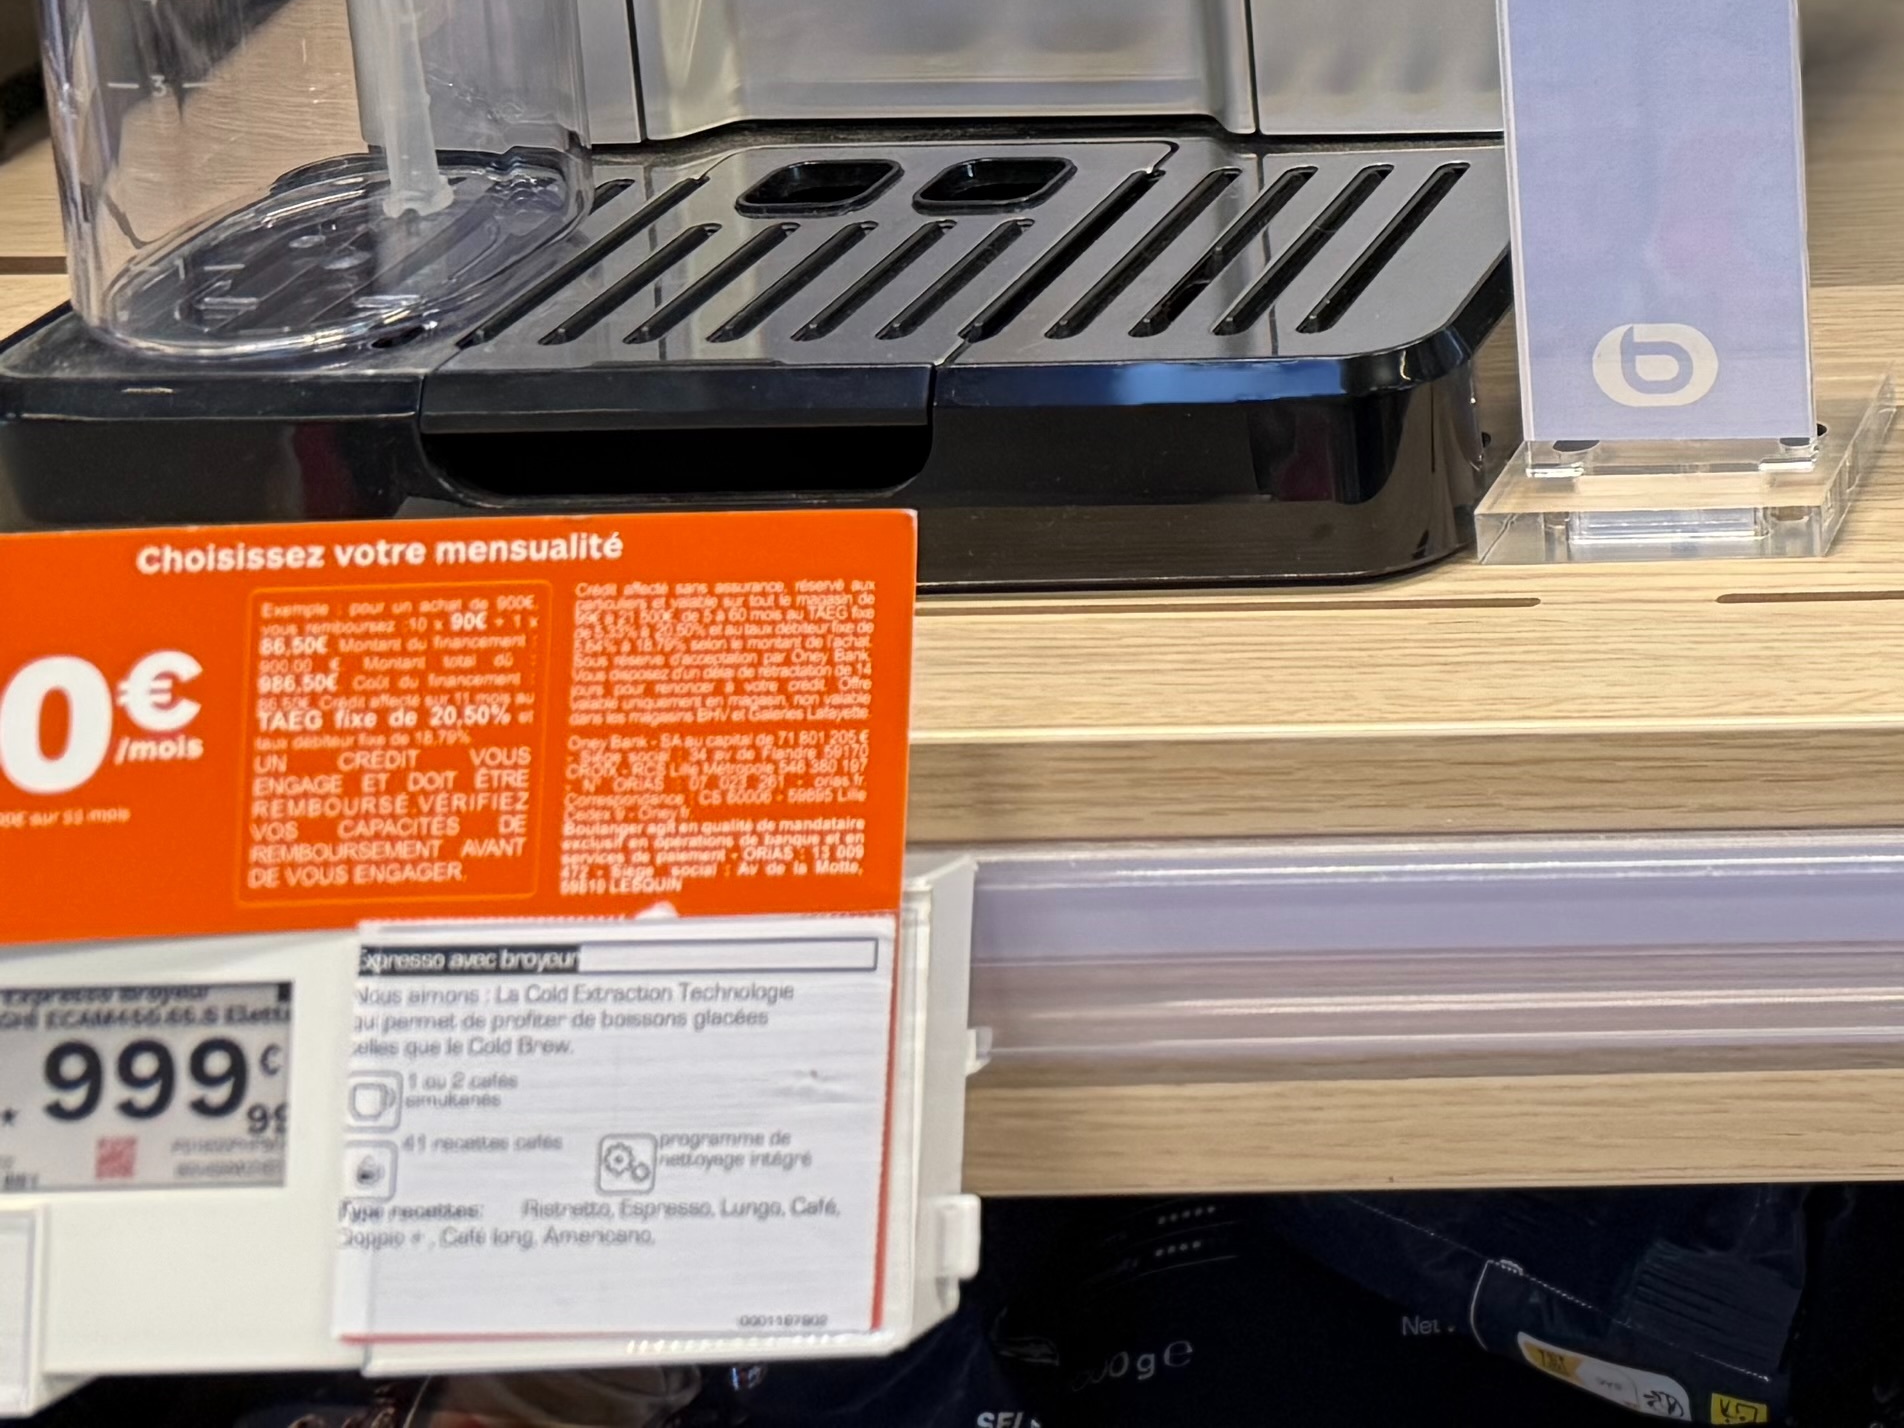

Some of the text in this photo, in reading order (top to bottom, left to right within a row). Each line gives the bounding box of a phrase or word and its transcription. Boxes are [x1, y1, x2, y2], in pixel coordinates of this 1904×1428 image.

[151, 76, 166, 97] 3
[137, 533, 623, 576] Choisissez votre mensualité
[114, 735, 204, 766] /mois
[45, 1038, 248, 1122] 999
